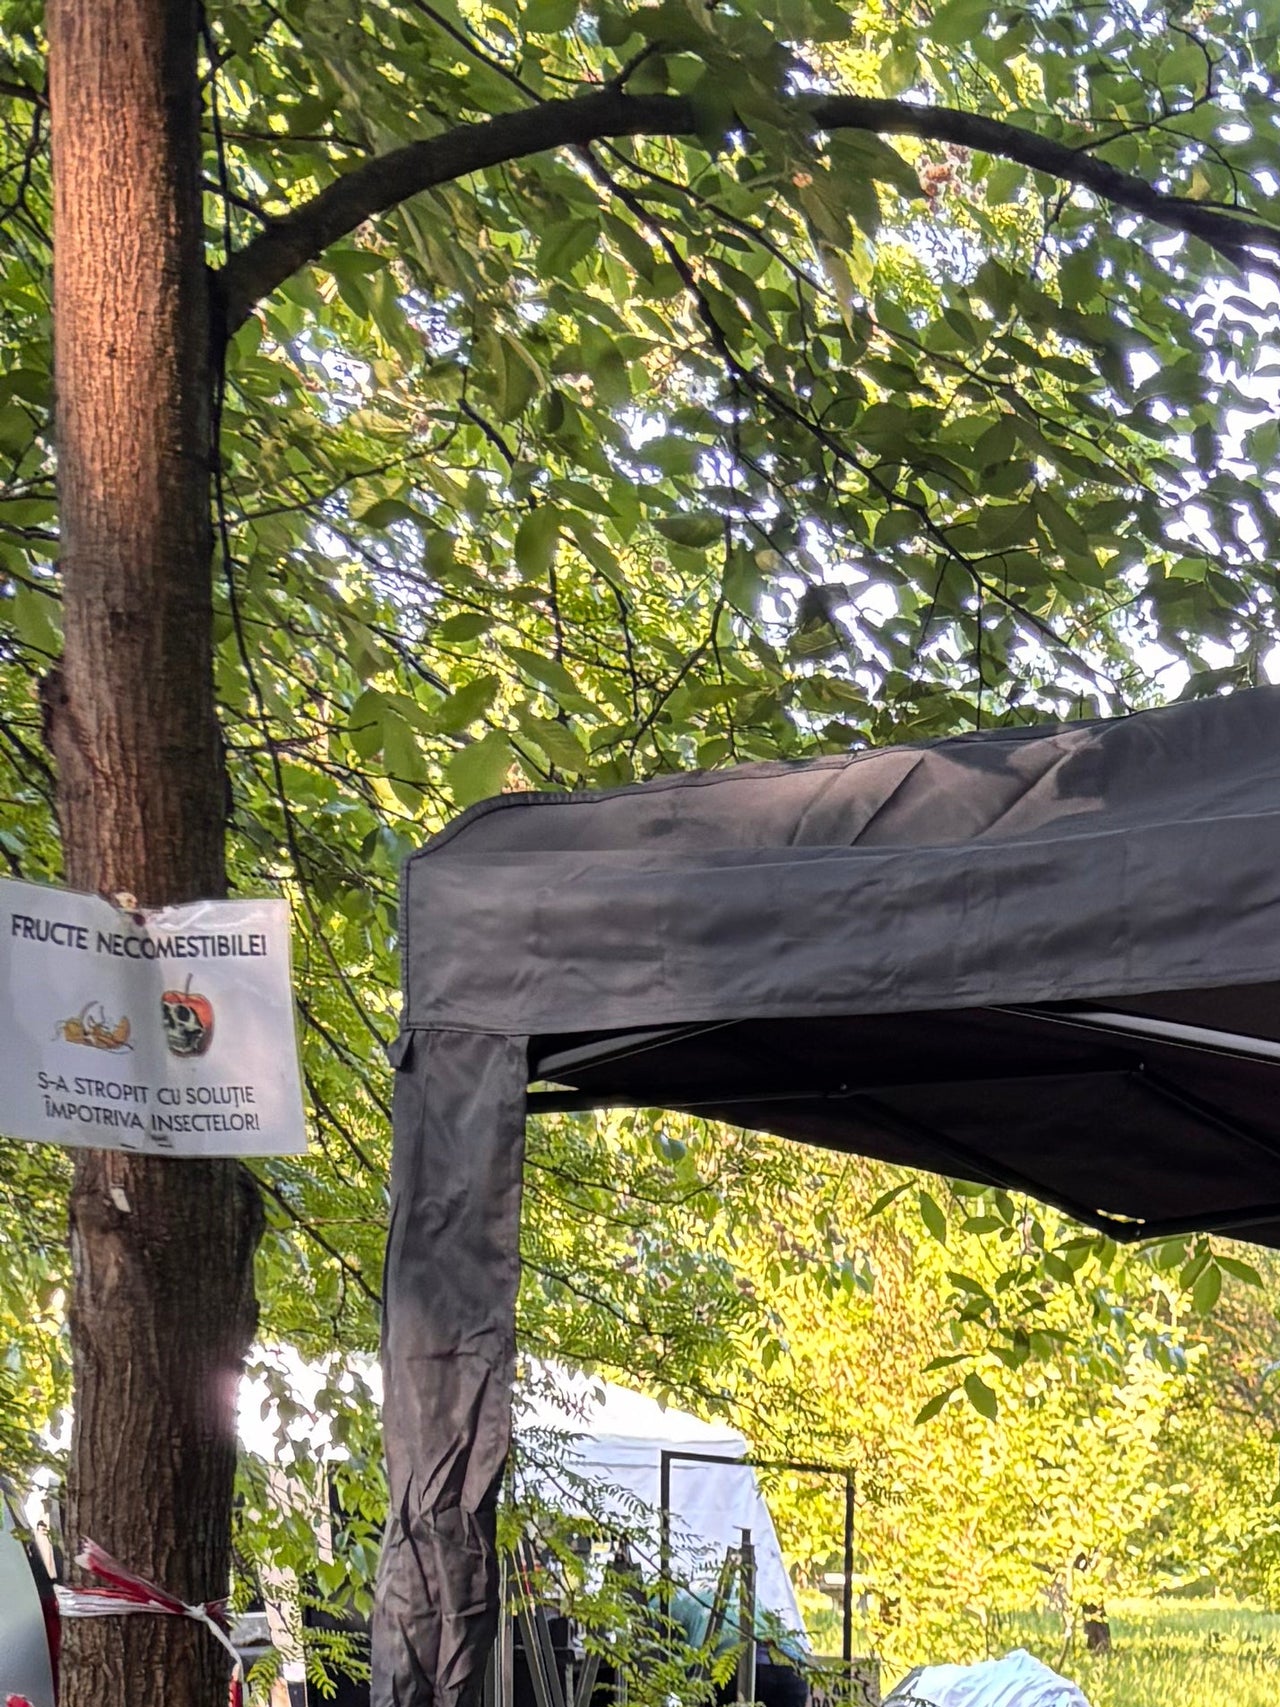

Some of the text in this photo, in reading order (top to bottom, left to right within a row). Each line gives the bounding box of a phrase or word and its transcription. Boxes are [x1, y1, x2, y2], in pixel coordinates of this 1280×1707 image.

[11, 914, 267, 958] FRUCTE NECOMESTIBILE!
[38, 1072, 256, 1108] S-A STROPIT CU SOLUȚIE
[44, 1095, 260, 1132] ÎMPOTRIVA INSECTELOR!
